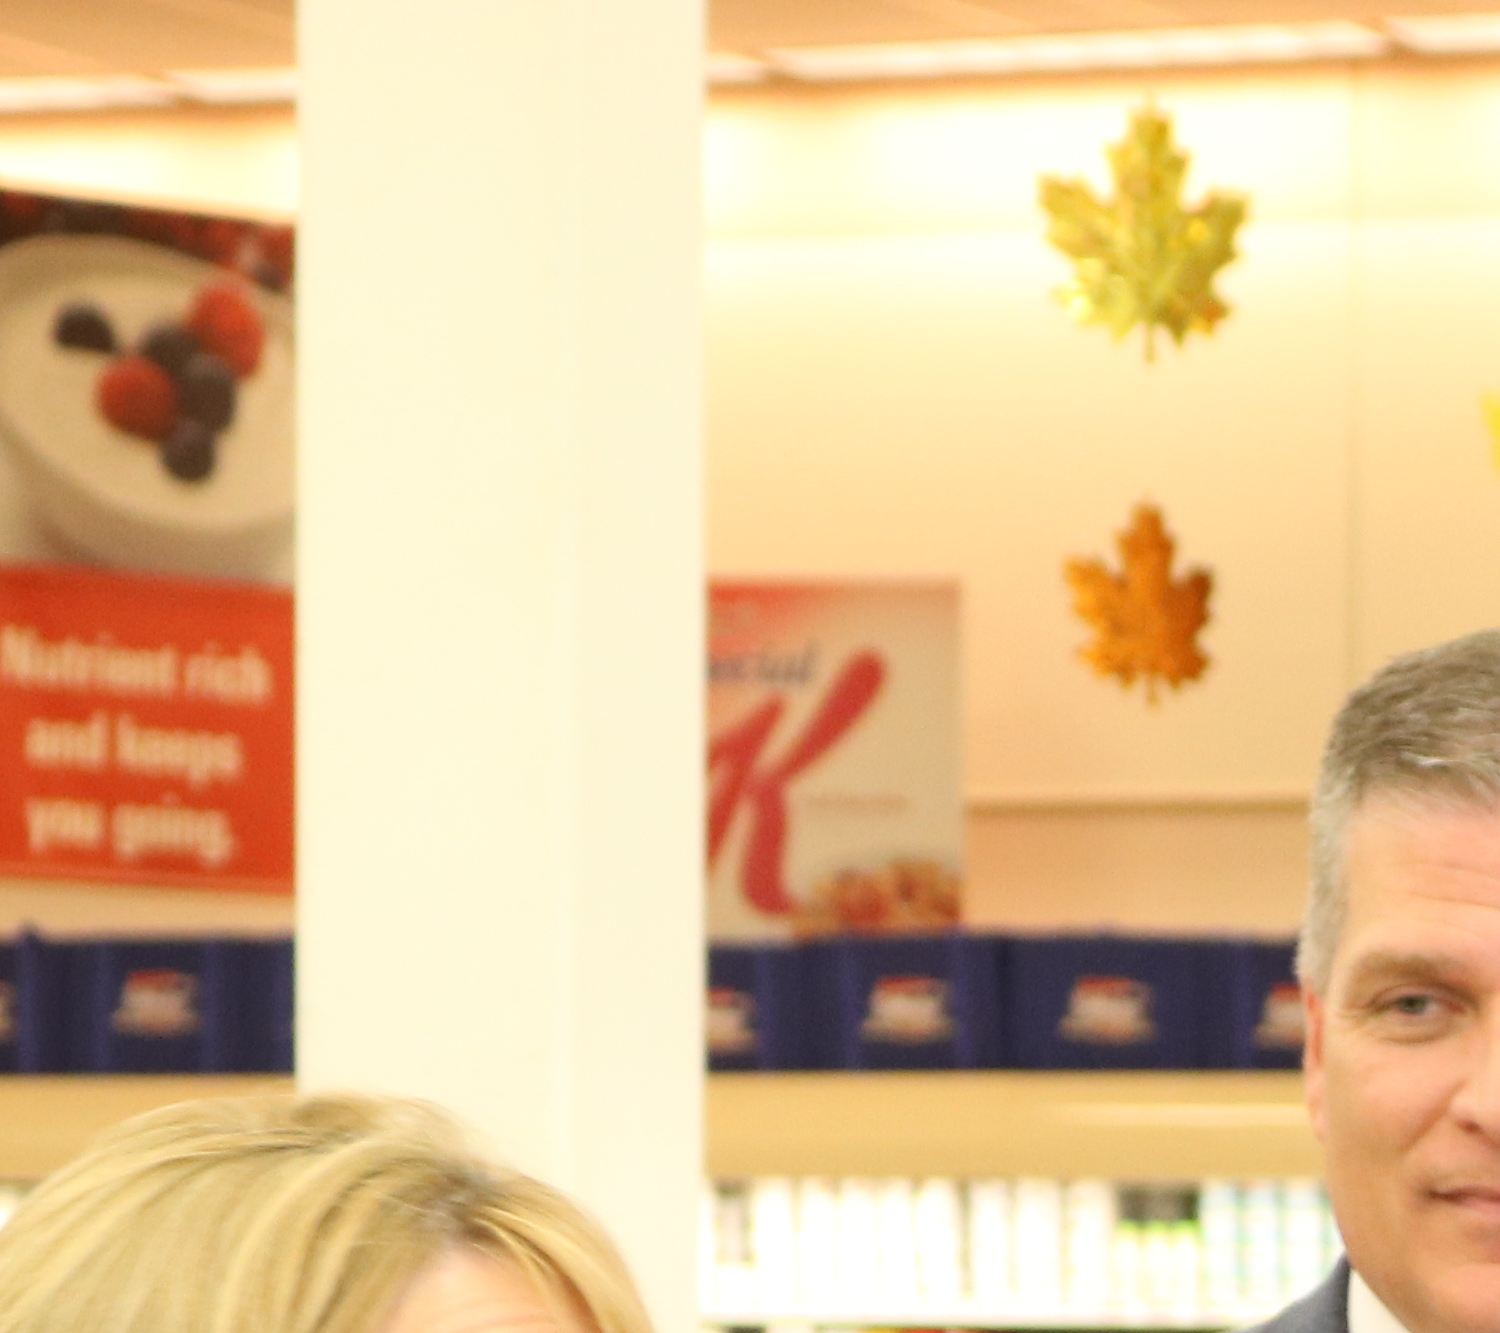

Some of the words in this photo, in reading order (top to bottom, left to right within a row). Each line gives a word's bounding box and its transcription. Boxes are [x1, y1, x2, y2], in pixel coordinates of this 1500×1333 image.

[183, 640, 273, 706] rich
[24, 710, 107, 770] and
[115, 713, 243, 790] keeps
[706, 648, 888, 916] K
[25, 800, 102, 855] you
